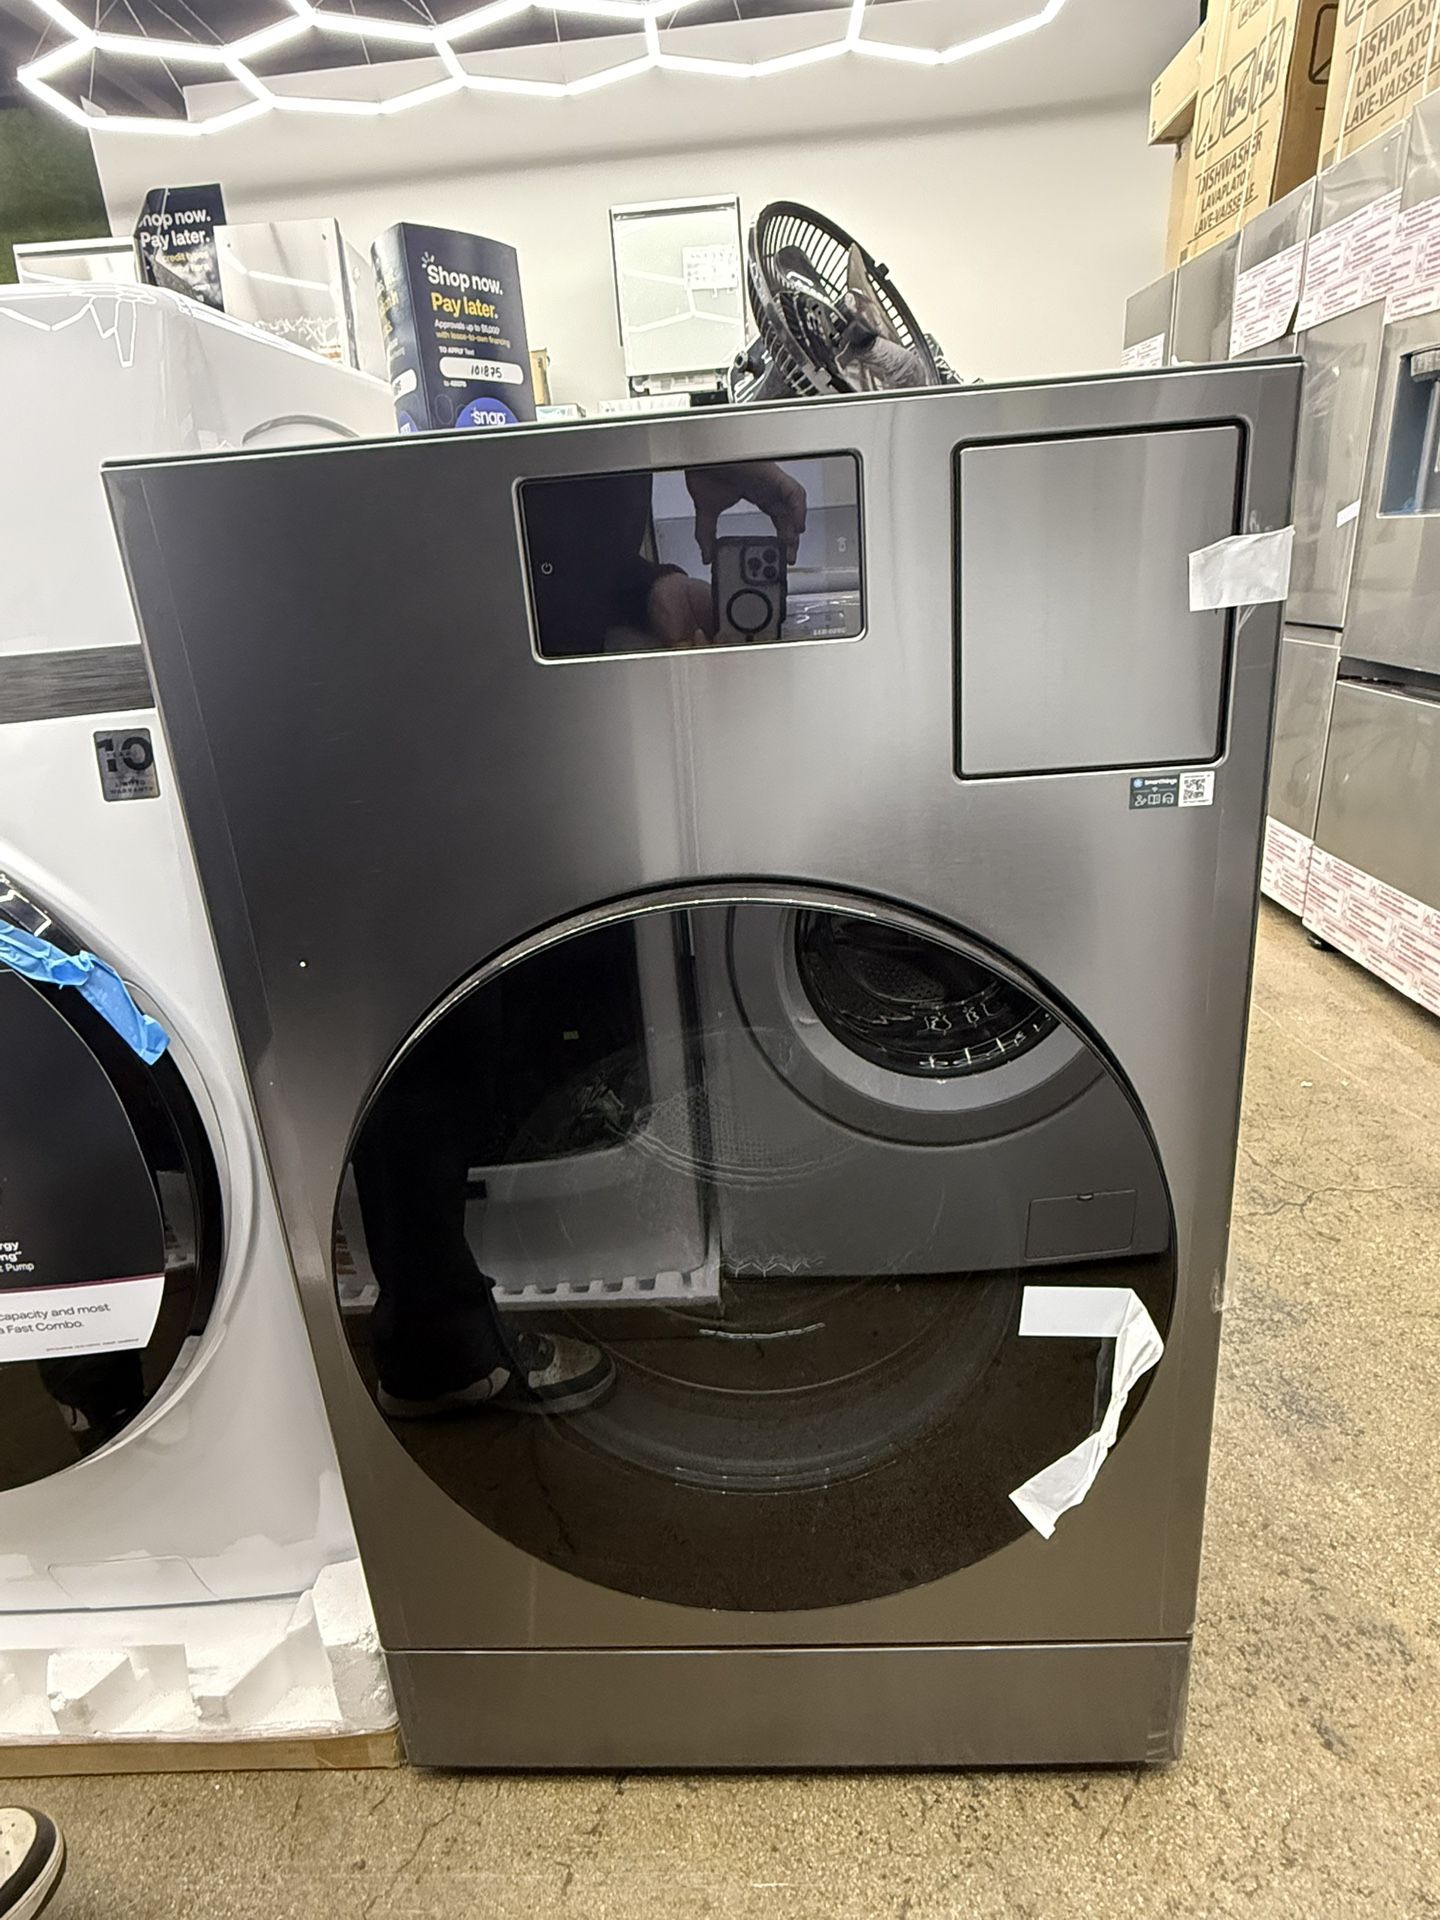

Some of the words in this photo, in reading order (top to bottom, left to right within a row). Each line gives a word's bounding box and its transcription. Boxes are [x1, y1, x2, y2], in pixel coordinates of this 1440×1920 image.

[1353, 0, 1437, 72] DISHWASH
[1357, 22, 1439, 98] LAVAPLATO
[1202, 169, 1249, 213] LAVAPLATO
[174, 209, 211, 225] now.
[1195, 182, 1255, 236] LAVE-VAISSELE
[140, 231, 169, 251] Pay
[171, 229, 210, 247] later.
[427, 264, 470, 292] Shop
[471, 275, 503, 295] now.
[431, 292, 461, 318] Pay
[463, 296, 498, 319] later.
[471, 365, 502, 378] 101875
[473, 408, 506, 425] snap
[96, 737, 153, 772] 10
[5, 1263, 34, 1272] Pump
[0, 1310, 48, 1322] capacity
[51, 1307, 75, 1316] and
[77, 1304, 111, 1314] most
[6, 1325, 34, 1334] Fast
